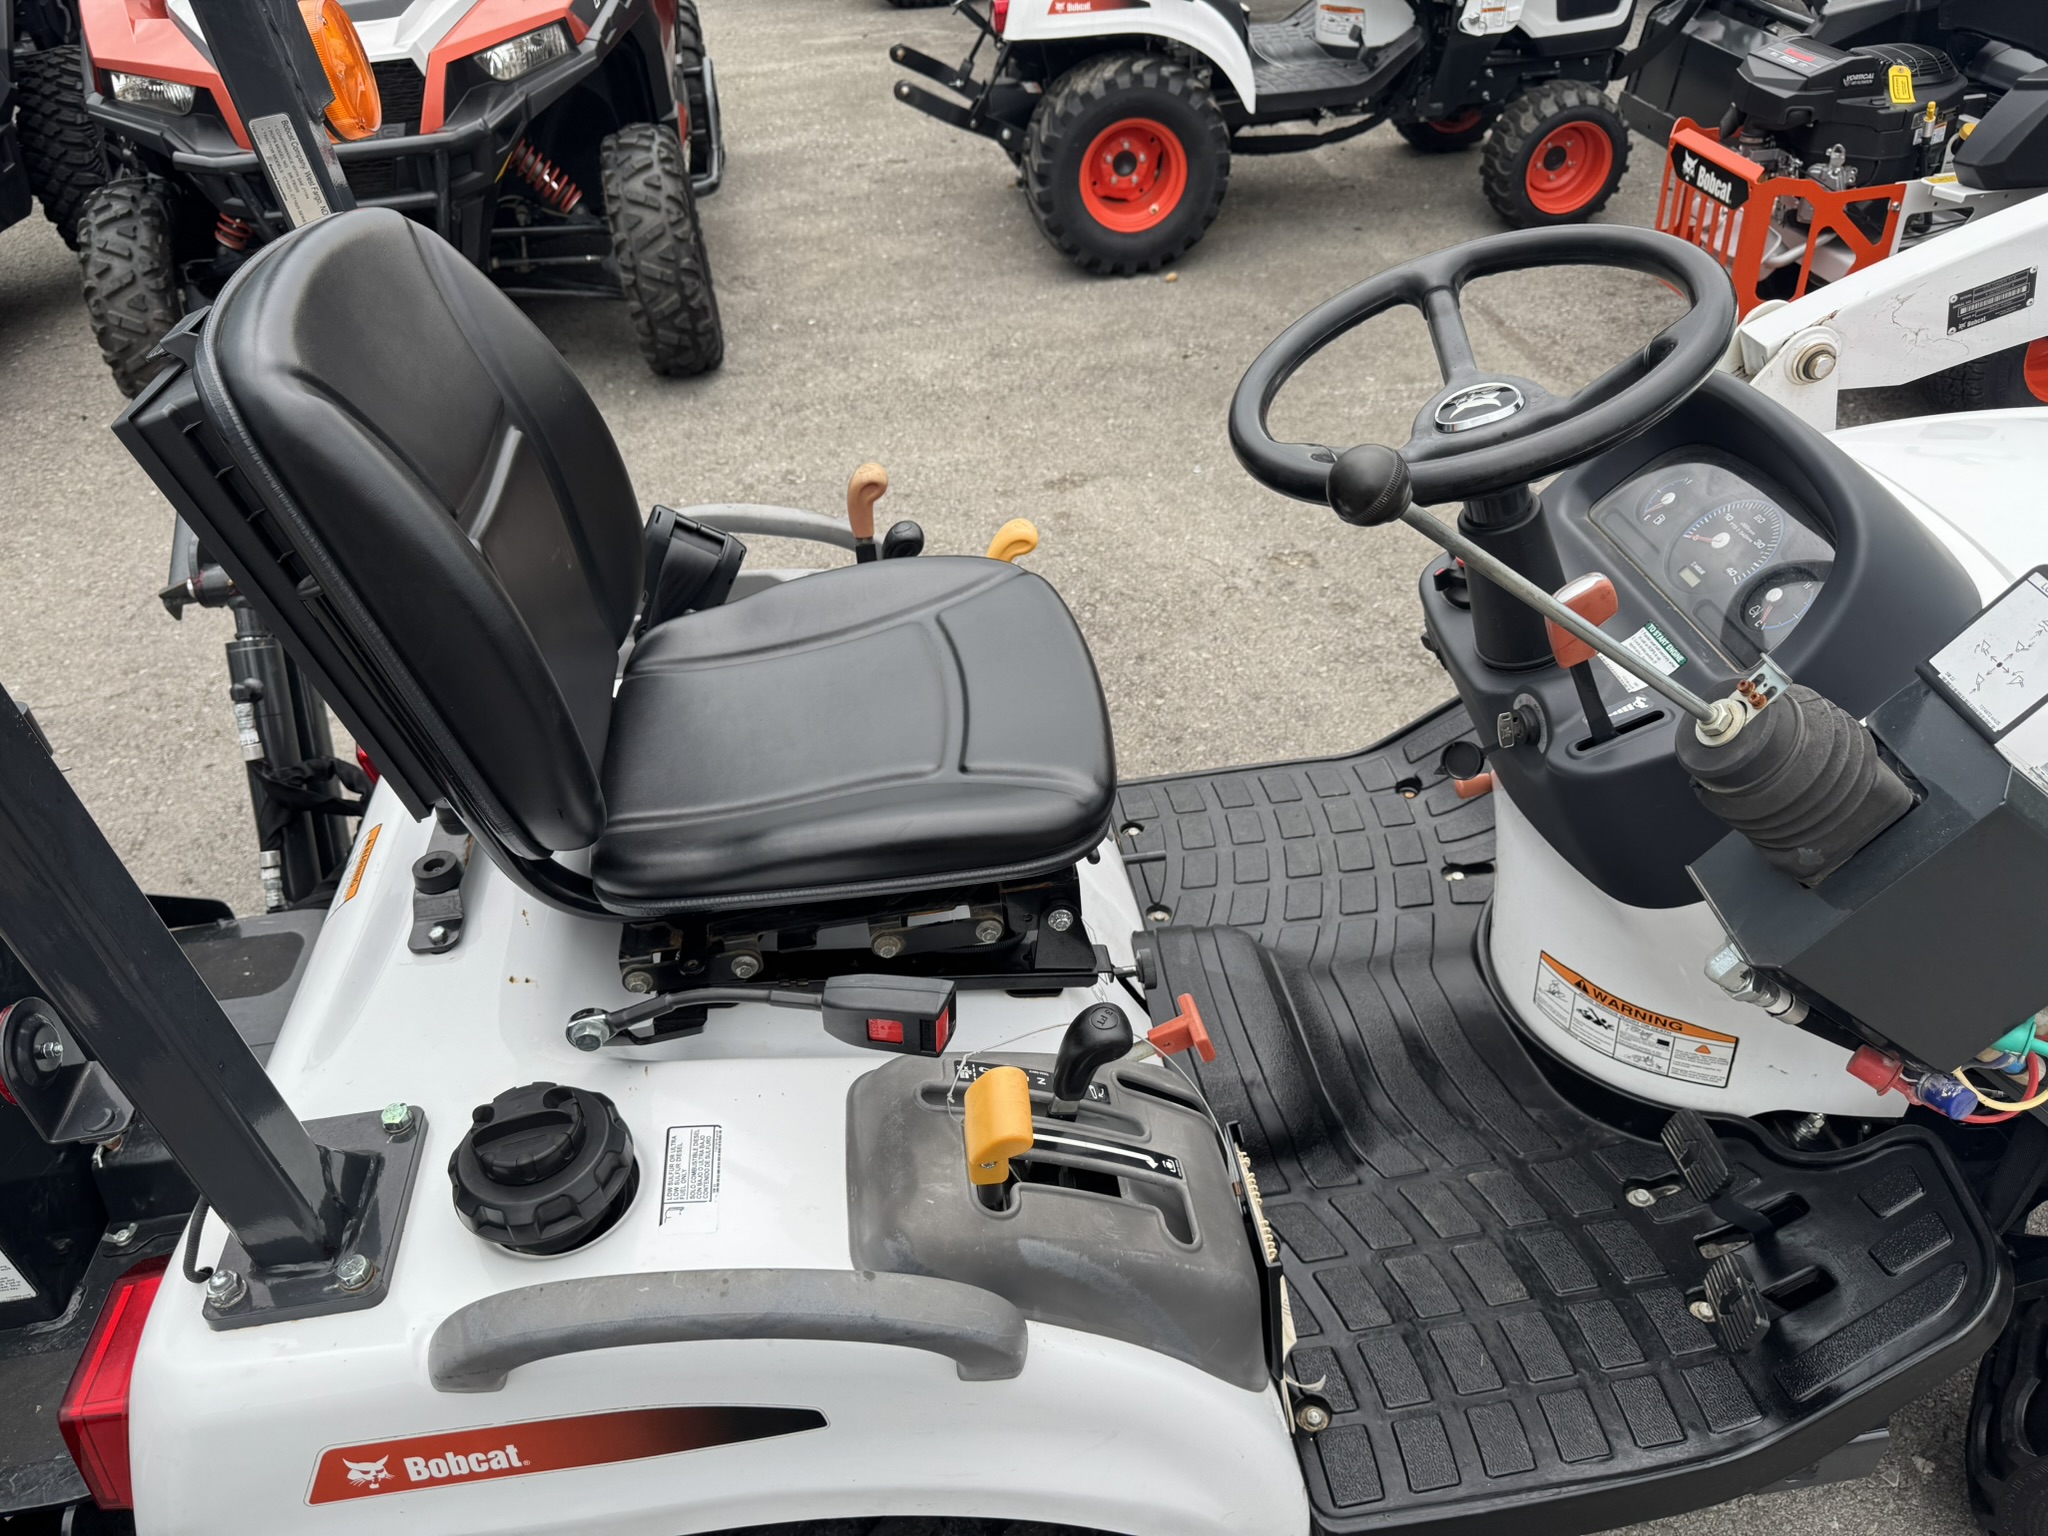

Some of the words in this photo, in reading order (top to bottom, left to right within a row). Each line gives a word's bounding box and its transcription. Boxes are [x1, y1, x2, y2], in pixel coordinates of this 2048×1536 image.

[280, 120, 295, 140] Bobcat
[303, 171, 315, 185] West
[309, 187, 323, 204] Fargo,
[1696, 165, 1732, 203] Bobcat
[1967, 315, 1986, 327] Bobcat
[1724, 513, 1734, 522] 10
[1753, 514, 1766, 524] 20
[1753, 540, 1766, 549] 30
[1726, 567, 1738, 577] 40
[1646, 623, 1656, 632] TO
[1652, 630, 1669, 646] START
[1665, 643, 1684, 662] ENGINE
[1104, 1008, 1113, 1017] 3
[1592, 988, 1683, 1032] WARNING
[1096, 1014, 1109, 1027] PT
[669, 1154, 675, 1162] OR
[690, 1147, 698, 1183] COMBUSTIBLE
[403, 1443, 523, 1482] Bobcat
